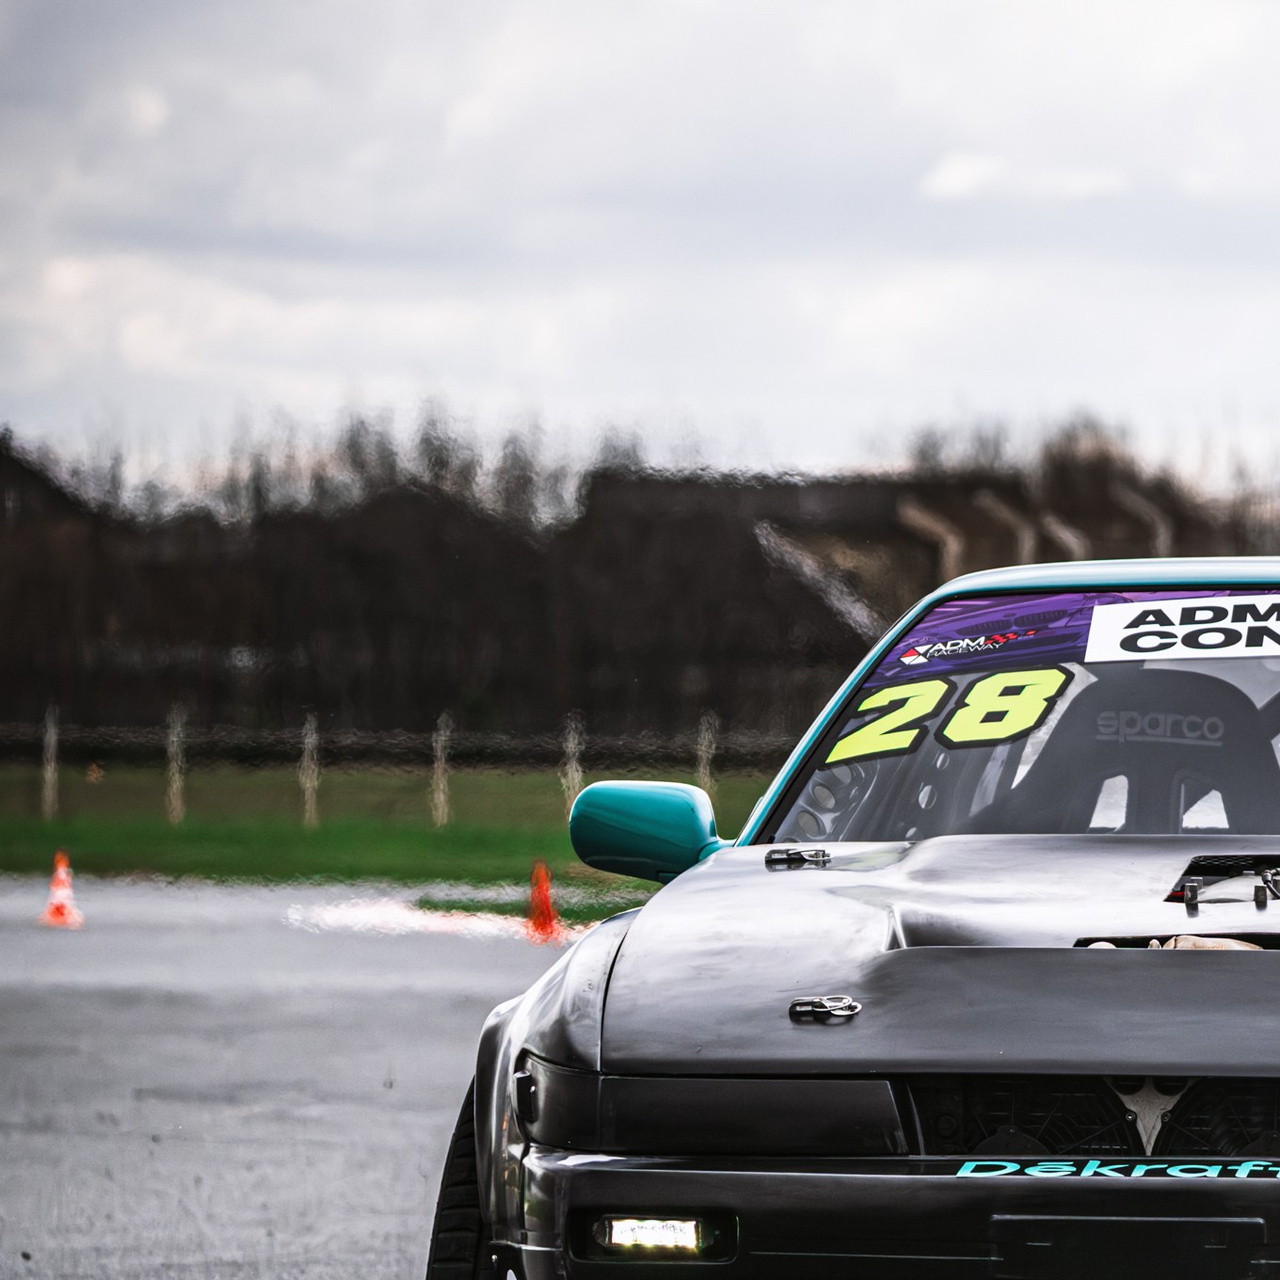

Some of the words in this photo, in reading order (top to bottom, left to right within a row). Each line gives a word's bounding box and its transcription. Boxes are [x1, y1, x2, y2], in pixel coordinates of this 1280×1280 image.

[927, 642, 1004, 658] RACEWAY
[929, 636, 986, 652] ADM
[825, 668, 1069, 764] 28
[1097, 710, 1224, 743] sparco
